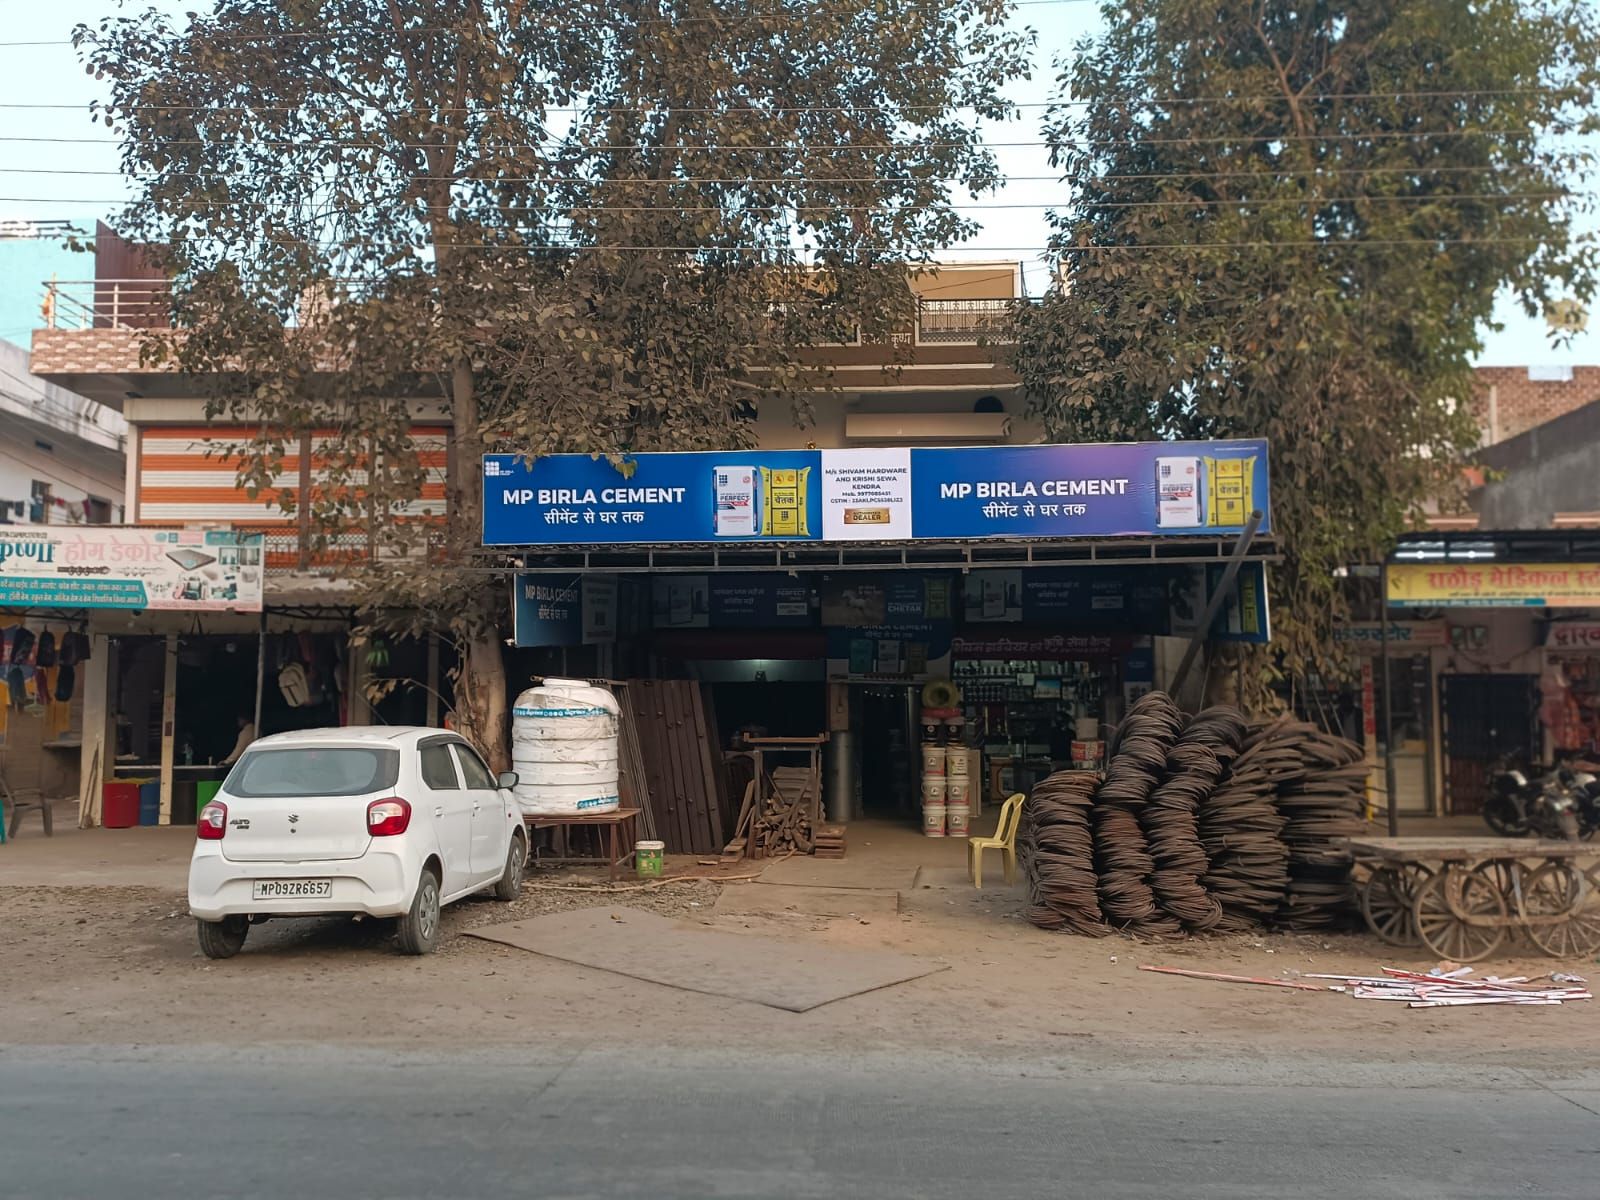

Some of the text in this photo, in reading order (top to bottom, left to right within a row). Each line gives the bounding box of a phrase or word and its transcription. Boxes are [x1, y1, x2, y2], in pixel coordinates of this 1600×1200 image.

[503, 487, 686, 505] MP BIRLA CEMENT
[940, 479, 1129, 499] MP BIRLA CEMENT
[543, 507, 645, 525] सीमेंट से घर तक
[981, 501, 1087, 519] सीमेंट से घर तक
[64, 534, 104, 565] होम
[109, 533, 168, 564] डेकोर
[1490, 565, 1569, 587] मेडिकल
[525, 584, 536, 600] MP
[536, 585, 555, 601] BIRLA
[260, 882, 331, 897] MP09ZR6657
